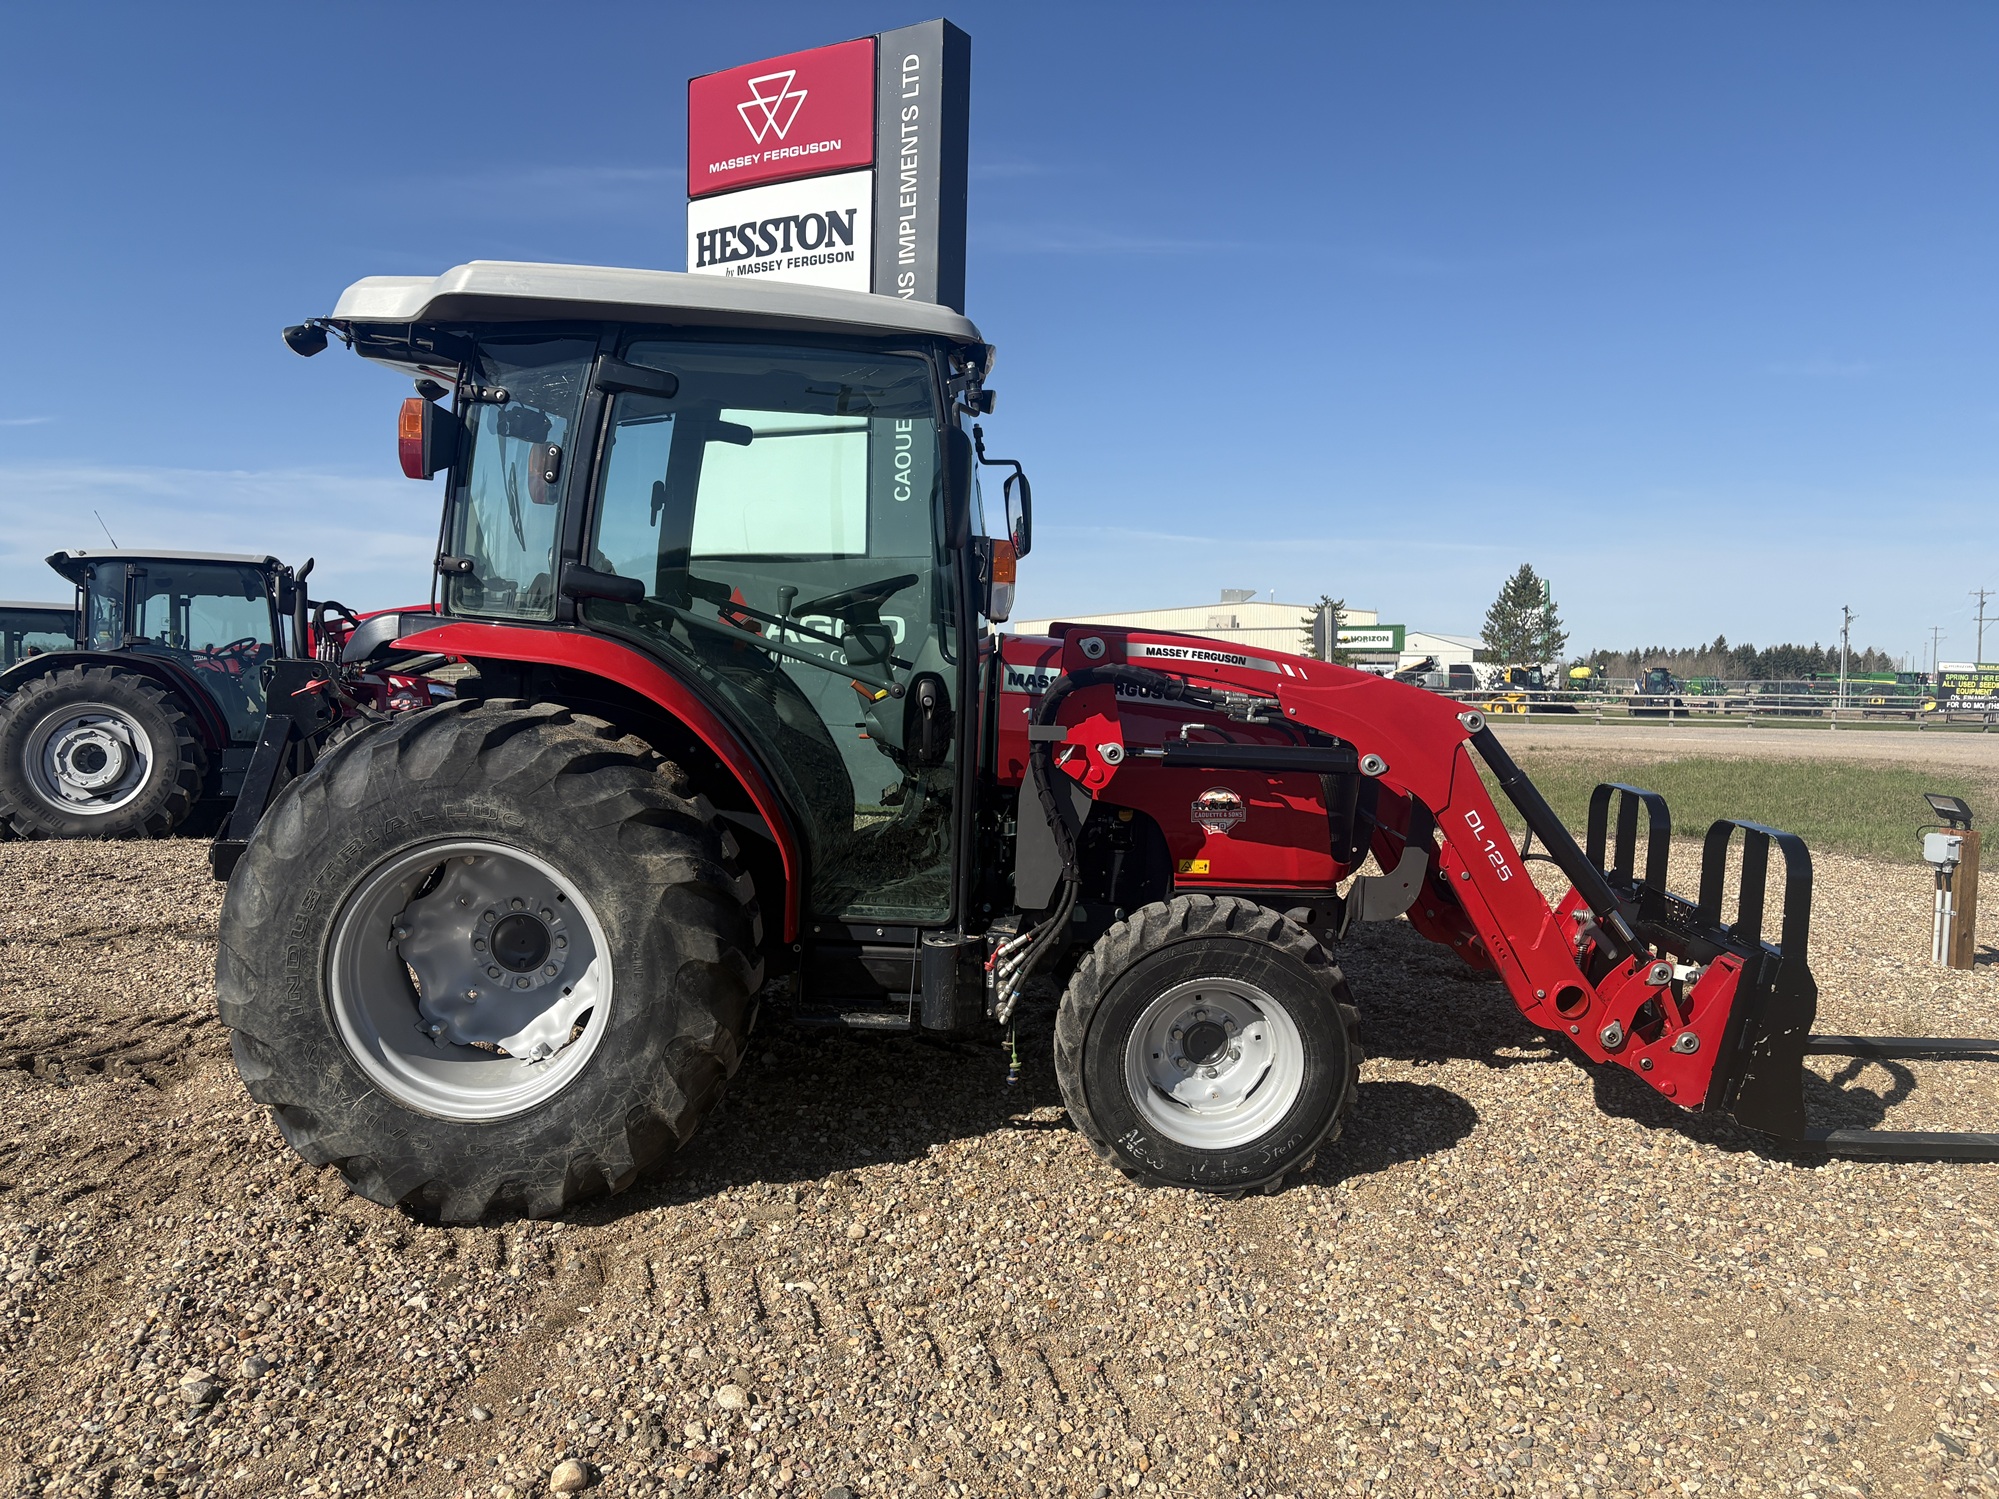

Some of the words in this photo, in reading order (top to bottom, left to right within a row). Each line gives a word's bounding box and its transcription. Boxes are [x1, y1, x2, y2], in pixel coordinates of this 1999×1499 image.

[902, 53, 920, 99] LTD
[709, 152, 761, 174] MASSEY
[763, 139, 842, 163] FERGUSON
[898, 104, 919, 265] IMPLEMENTS
[696, 208, 857, 268] HESSTON
[737, 259, 783, 276] MASSEY
[787, 251, 854, 269] FERGUSON
[1145, 647, 1189, 658] MASSEY
[1191, 650, 1247, 665] FERGUSON
[1942, 680, 1955, 688] ALL
[1945, 673, 1969, 681] SPRING
[1981, 674, 1999, 682] HERE
[1956, 688, 1993, 696] EQUIPMENT
[1464, 809, 1485, 842] DL
[1484, 839, 1513, 882] 125
[286, 810, 435, 1016] INDUSTRIAL
[445, 804, 527, 828] LUG
